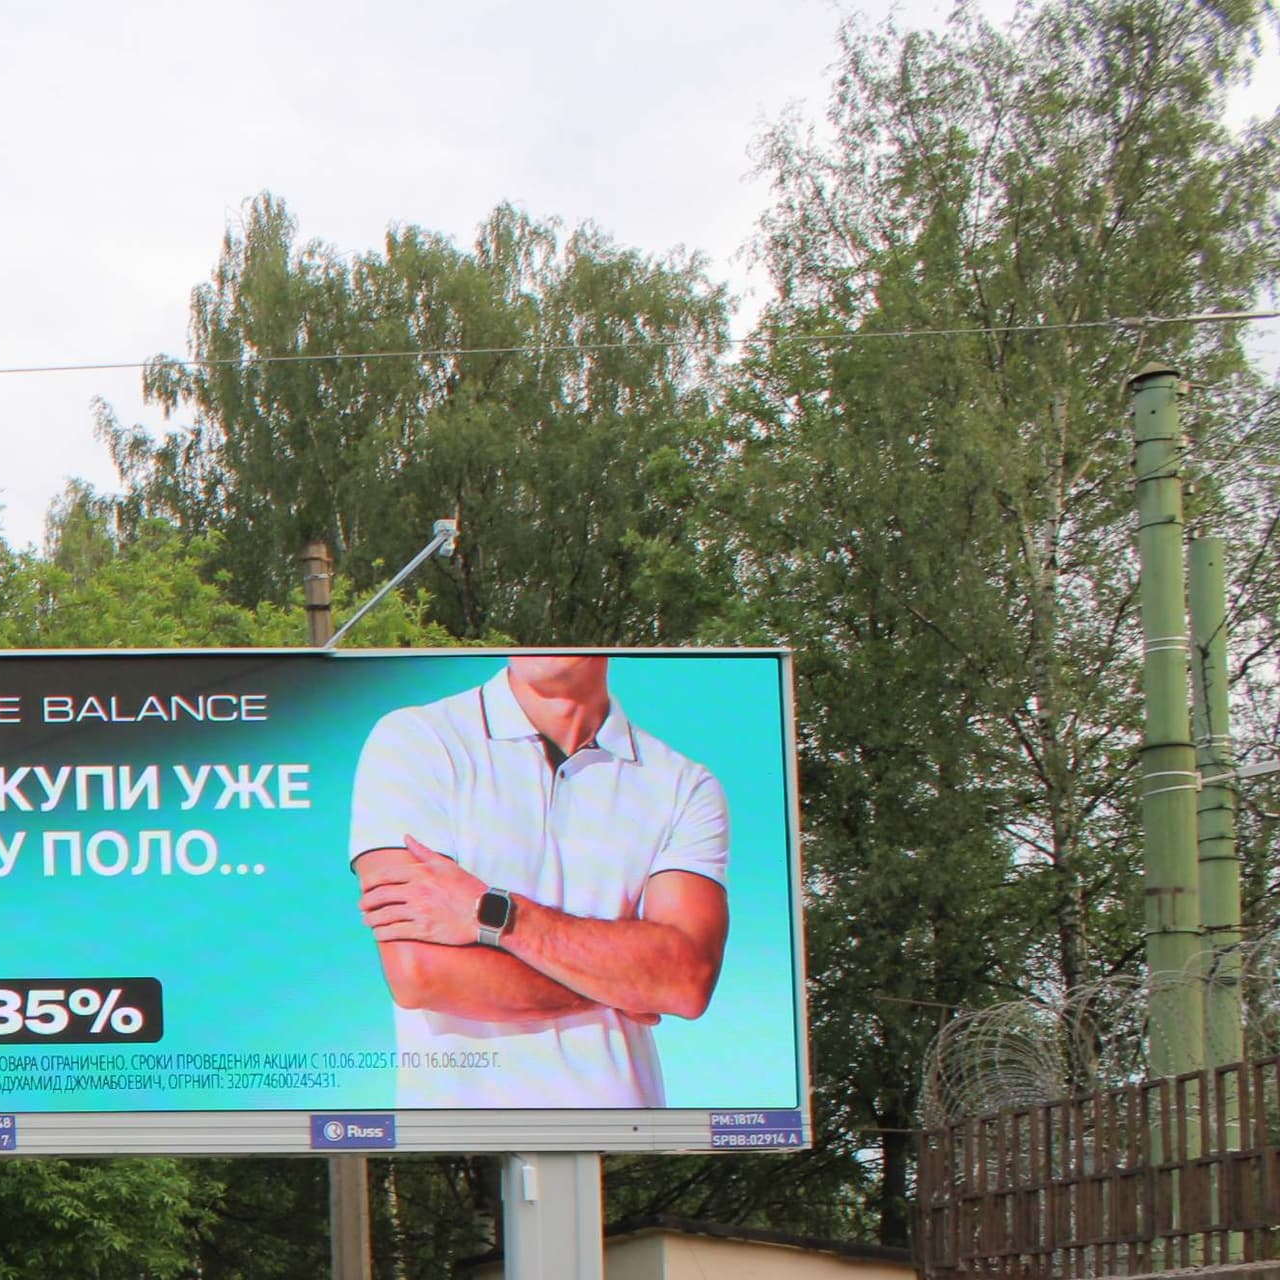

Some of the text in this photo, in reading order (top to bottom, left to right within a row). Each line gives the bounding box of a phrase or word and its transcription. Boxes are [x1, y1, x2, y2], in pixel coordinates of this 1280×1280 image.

[42, 695, 269, 723] BALANCE
[173, 764, 311, 809] УЖЕ
[42, 829, 266, 877] ПОЛО...
[40, 1054, 128, 1072] ОГРАНИЧЕНО.
[130, 1054, 173, 1070] СРОКИ
[176, 1053, 260, 1072] ПРОВЕДЕНИЯ
[263, 1053, 308, 1071] АКЦИИ
[310, 1053, 319, 1069] С
[322, 1052, 387, 1069] 10.06.2025
[402, 1052, 421, 1068] ПО
[424, 1052, 489, 1069] 16.06.2025
[168, 1074, 223, 1090] ОГРНИП:
[347, 1125, 384, 1138] Russ
